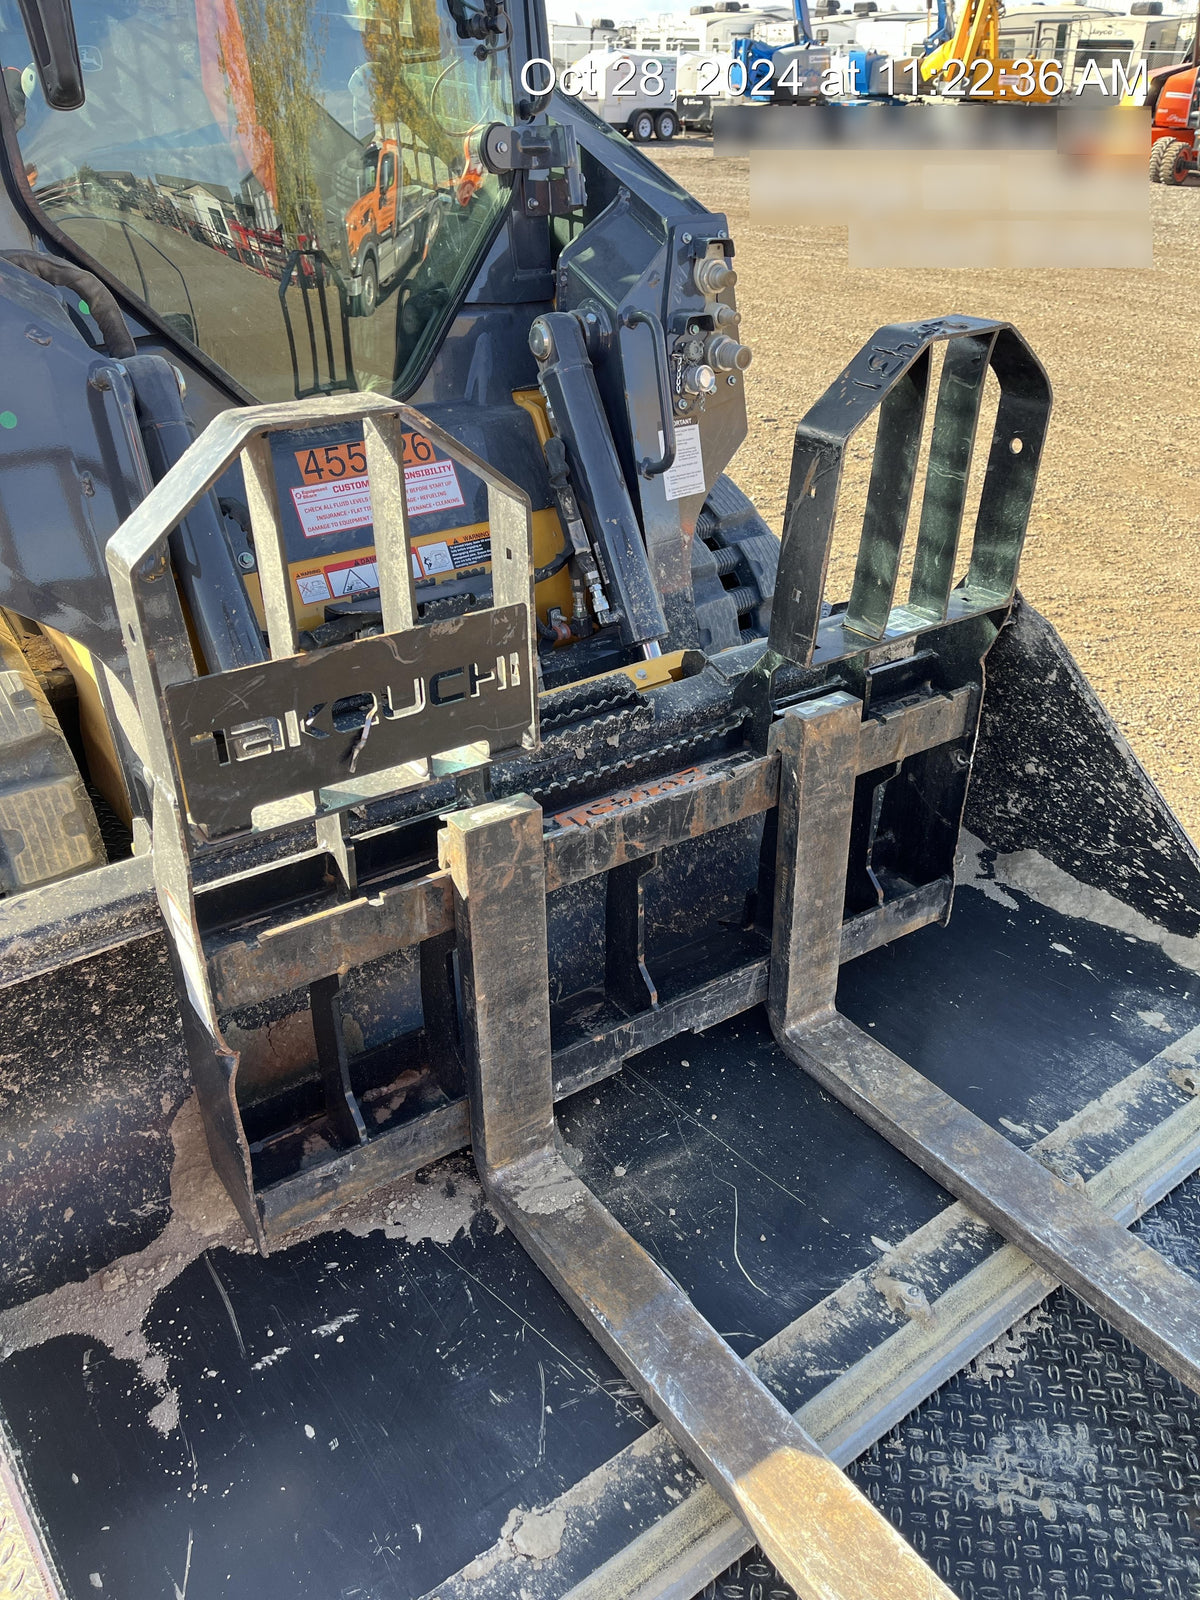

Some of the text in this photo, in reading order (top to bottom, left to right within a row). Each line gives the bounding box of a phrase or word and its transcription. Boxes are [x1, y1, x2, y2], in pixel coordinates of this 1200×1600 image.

[333, 464, 452, 493] CUSTOM ONSIBILITY
[410, 485, 428, 493] BEFORE
[419, 490, 447, 502] REFUELING
[435, 496, 460, 507] CLEANING
[333, 500, 349, 508] FLUID
[350, 497, 368, 505] LEVELS
[316, 511, 347, 521] INSURANCE
[307, 522, 331, 533] DAMAGE
[338, 515, 370, 526] EQUIPMENT
[463, 531, 490, 541] WARNING
[300, 568, 321, 577] WARNING
